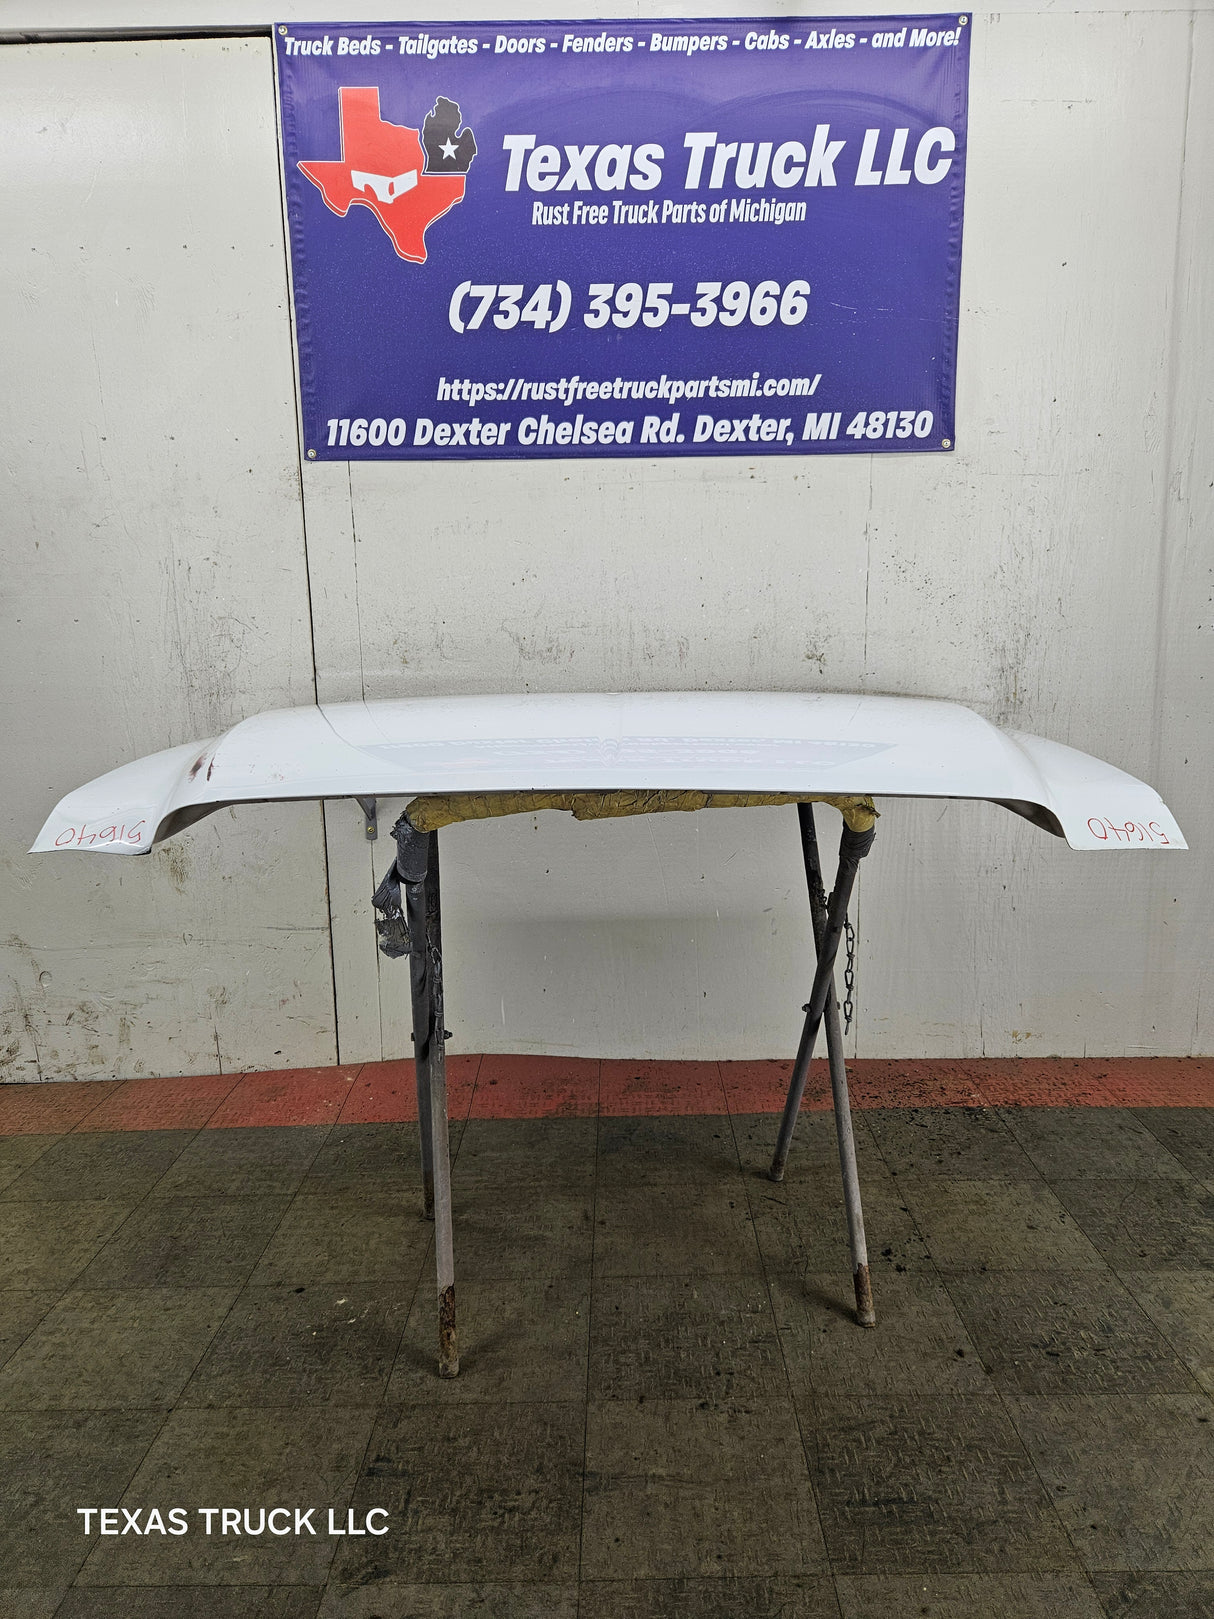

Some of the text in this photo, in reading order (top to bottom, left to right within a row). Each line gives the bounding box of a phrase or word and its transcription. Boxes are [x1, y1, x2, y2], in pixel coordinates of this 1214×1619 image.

[284, 36, 334, 56] Truck
[336, 35, 382, 55] Beds
[398, 34, 479, 59] Tailgates
[494, 35, 547, 54] Doors
[561, 33, 634, 53] Fenders
[649, 33, 729, 56] Bumpers
[744, 31, 790, 51] Cabs
[804, 29, 856, 50] Axles
[871, 28, 909, 49] and
[909, 26, 962, 48] More!
[502, 123, 956, 193] Texas Truck LLC
[531, 197, 807, 226] Rust Free Truck Parts of Michigan
[448, 279, 811, 334] (734) 395-3966
[436, 372, 823, 407] https://rustfreetruckpartsmi.com/
[327, 410, 934, 447] 11600 Dexter Chelsea Rd. Dexter, MI 48130
[55, 820, 146, 847] 51640
[1087, 816, 1170, 844] 51640
